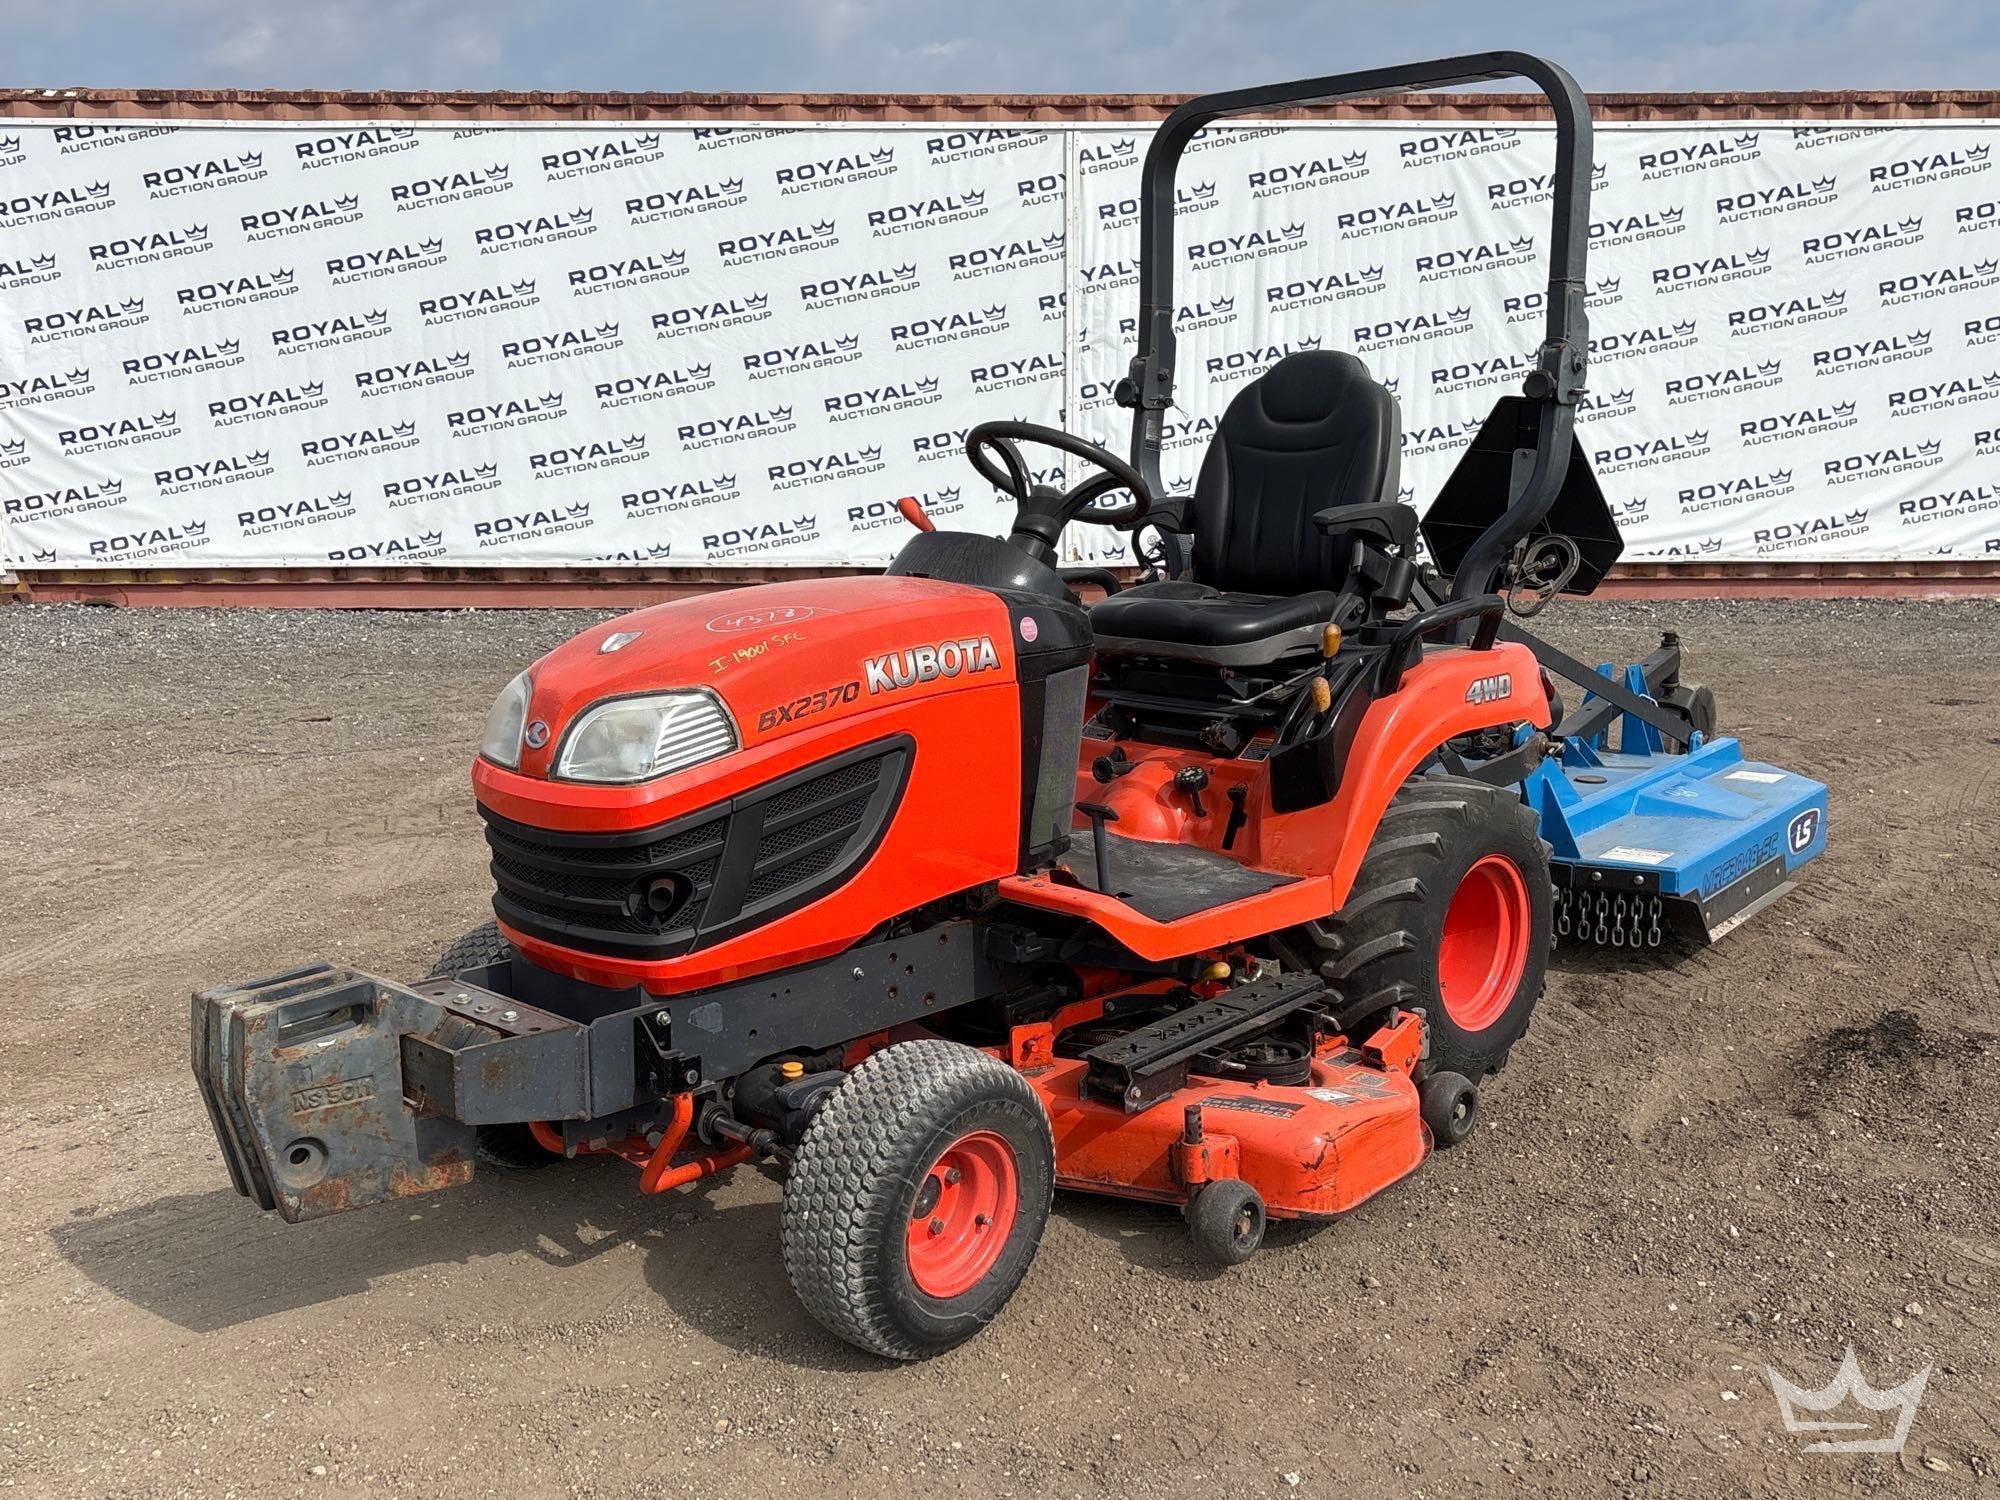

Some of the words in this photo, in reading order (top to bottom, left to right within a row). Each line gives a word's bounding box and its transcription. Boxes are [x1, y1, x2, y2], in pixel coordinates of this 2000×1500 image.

[142, 158, 239, 188] ROYAL
[775, 154, 870, 184] ROYAL
[780, 176, 844, 195] AUCTION
[847, 165, 897, 182] GROUP
[1247, 157, 1342, 187] ROYAL
[1869, 151, 1964, 182] ROYAL
[1871, 173, 1937, 193] AUCTION
[1940, 162, 1991, 179] GROUP
[149, 180, 214, 199] AUCTION
[216, 170, 267, 186] GROUP
[390, 171, 485, 201] ROYAL
[396, 192, 460, 211] AUCTION
[463, 182, 512, 198] GROUP
[1252, 179, 1316, 198] AUCTION
[1319, 168, 1369, 185] GROUP
[624, 184, 720, 214] ROYAL
[630, 206, 694, 225] AUCTION
[697, 195, 747, 212] GROUP
[867, 196, 961, 226] ROYAL
[1715, 183, 1811, 213] ROYAL
[1718, 204, 1783, 224] AUCTION
[1786, 194, 1837, 210] GROUP
[240, 201, 335, 231] ROYAL
[246, 223, 310, 242] AUCTION
[313, 212, 363, 228] GROUP
[872, 218, 935, 237] AUCTION
[938, 207, 988, 224] GROUP
[1336, 199, 1431, 229] ROYAL
[1340, 221, 1404, 239] AUCTION
[1407, 210, 1457, 226] GROUP
[474, 214, 569, 244] ROYAL
[479, 236, 543, 255] AUCTION
[546, 225, 596, 241] GROUP
[717, 226, 812, 256] ROYAL
[1802, 223, 1897, 254] ROYAL
[88, 230, 185, 260] ROYAL
[95, 252, 160, 271] AUCTION
[162, 242, 213, 258] GROUP
[325, 244, 419, 274] ROYAL
[722, 248, 786, 267] AUCTION
[789, 238, 838, 254] GROUP
[1187, 229, 1281, 260] ROYAL
[1191, 251, 1254, 271] AUCTION
[1257, 240, 1307, 257] GROUP
[1415, 242, 1509, 271] ROYAL
[1804, 245, 1869, 264] AUCTION
[1873, 234, 1923, 251] GROUP
[331, 266, 394, 285] AUCTION
[397, 255, 446, 272] GROUP
[567, 256, 662, 285] ROYAL
[573, 277, 637, 296] AUCTION
[639, 267, 689, 283] GROUP
[1418, 264, 1482, 282] AUCTION
[1486, 253, 1535, 269] GROUP
[1651, 254, 1745, 284] ROYAL
[1654, 276, 1718, 294] AUCTION
[1721, 265, 1771, 281] GROUP
[176, 274, 271, 304] ROYAL
[799, 270, 893, 299] ROYAL
[804, 291, 867, 310] AUCTION
[870, 281, 919, 297] GROUP
[1265, 272, 1359, 302] ROYAL
[1269, 293, 1333, 313] AUCTION
[1336, 283, 1385, 299] GROUP
[182, 296, 246, 315] AUCTION
[249, 286, 298, 302] GROUP
[418, 285, 512, 315] ROYAL
[424, 307, 487, 326] AUCTION
[490, 296, 539, 312] GROUP
[650, 299, 745, 328] ROYAL
[23, 304, 121, 333] ROYAL
[30, 325, 95, 344] AUCTION
[98, 315, 149, 331] GROUP
[271, 316, 364, 345] ROYAL
[656, 321, 719, 339] AUCTION
[722, 311, 771, 326] GROUP
[890, 311, 983, 340] ROYAL
[1353, 313, 1446, 342] ROYAL
[277, 337, 340, 355] AUCTION
[342, 326, 391, 342] GROUP
[501, 328, 596, 357] ROYAL
[894, 332, 957, 351] AUCTION
[960, 322, 1009, 338] GROUP
[1357, 334, 1420, 352] AUCTION
[1423, 323, 1473, 339] GROUP
[1812, 336, 1906, 366] ROYAL
[121, 345, 217, 374] ROYAL
[507, 350, 570, 368] AUCTION
[573, 339, 623, 355] GROUP
[742, 341, 835, 369] ROYAL
[747, 362, 810, 380] AUCTION
[813, 352, 862, 367] GROUP
[1815, 357, 1879, 376] AUCTION
[1882, 347, 1932, 363] GROUP
[128, 366, 192, 385] AUCTION
[194, 356, 244, 372] GROUP
[354, 358, 447, 387] ROYAL
[360, 379, 422, 397] AUCTION
[425, 368, 474, 384] GROUP
[594, 369, 688, 398] ROYAL
[1664, 366, 1756, 395] ROYAL
[207, 387, 301, 416] ROYAL
[600, 390, 663, 409] AUCTION
[665, 380, 715, 396] GROUP
[823, 383, 915, 412] ROYAL
[1667, 387, 1730, 405] AUCTION
[1733, 377, 1782, 392] GROUP
[214, 408, 276, 427] AUCTION
[279, 398, 328, 414] GROUP
[446, 398, 539, 427] ROYAL
[828, 404, 890, 422] AUCTION
[893, 394, 942, 409] GROUP
[451, 419, 514, 437] AUCTION
[517, 409, 566, 425] GROUP
[676, 412, 769, 440] ROYAL
[682, 433, 744, 451] AUCTION
[747, 423, 796, 438] GROUP
[1823, 446, 1916, 475] ROYAL
[1826, 467, 1889, 485] AUCTION
[1893, 456, 1942, 472] GROUP
[382, 469, 475, 497] ROYAL
[388, 489, 450, 507] AUCTION
[453, 479, 501, 495] GROUP
[1677, 475, 1768, 503] ROYAL
[2, 485, 99, 514] ROYAL
[9, 506, 74, 524] AUCTION
[76, 496, 126, 511] GROUP
[236, 498, 329, 526] ROYAL
[1680, 496, 1742, 514] AUCTION
[1745, 485, 1794, 501] GROUP
[242, 518, 304, 536] AUCTION
[307, 508, 355, 523] GROUP
[473, 508, 566, 537] ROYAL
[479, 529, 541, 547] AUCTION
[544, 519, 593, 534] GROUP
[701, 521, 793, 549] ROYAL
[706, 541, 768, 559] AUCTION
[771, 532, 819, 547] GROUP
[864, 634, 1001, 696] KUBOTA
[1465, 673, 1512, 705] 4WD
[758, 681, 860, 734] BX2370
